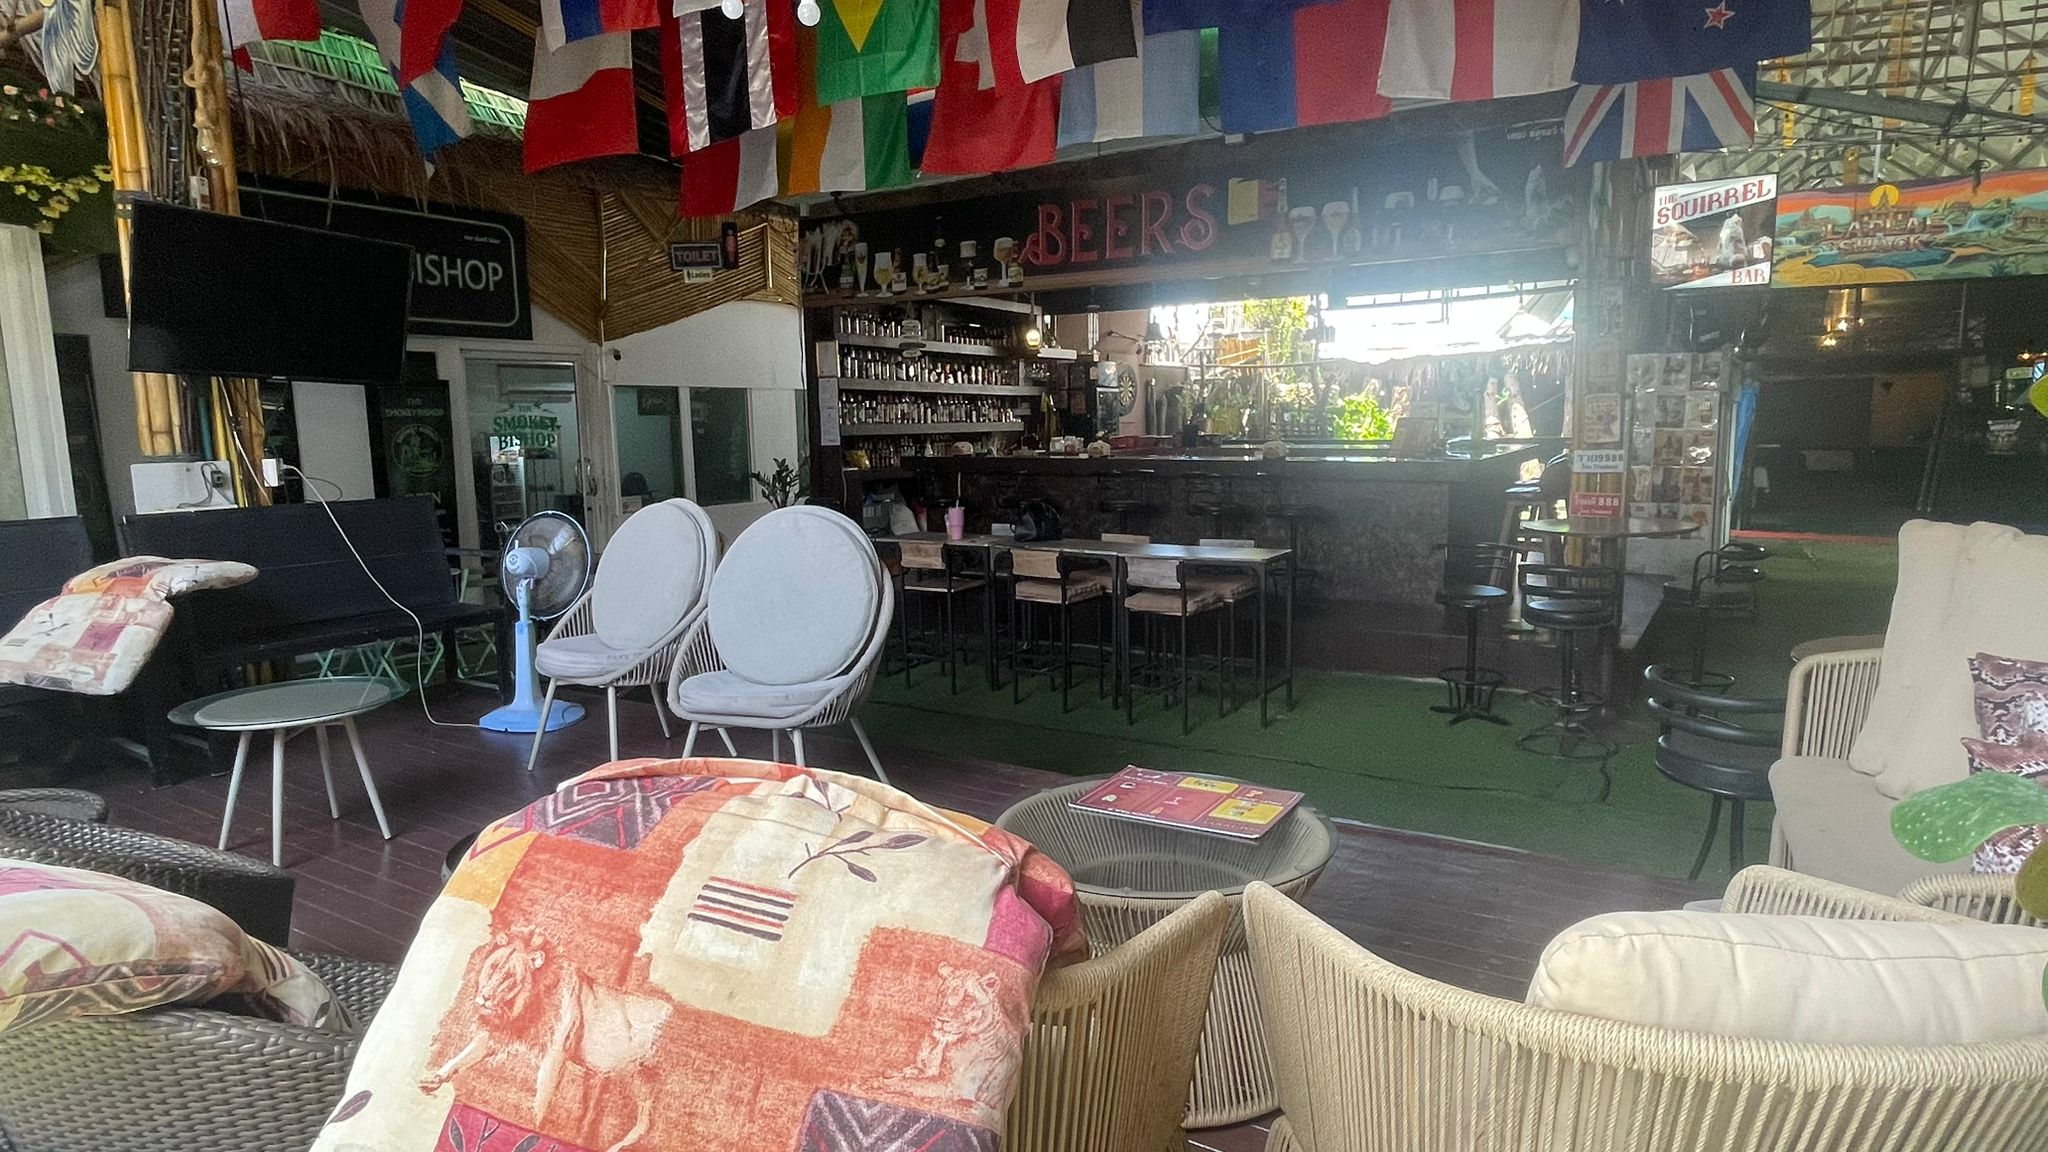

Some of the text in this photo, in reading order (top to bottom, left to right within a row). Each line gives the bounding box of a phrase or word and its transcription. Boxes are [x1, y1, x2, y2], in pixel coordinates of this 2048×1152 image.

[1657, 180, 1772, 225] SQUIRREL
[1660, 194, 1678, 206] THE
[1018, 184, 1216, 265] BEERS
[674, 250, 718, 262] TOILET
[415, 252, 503, 292] ISHOP
[1731, 269, 1765, 284] BAR
[493, 414, 558, 433] SMOKEY
[499, 431, 556, 451] BISHOP
[1598, 497, 1619, 507] 888
